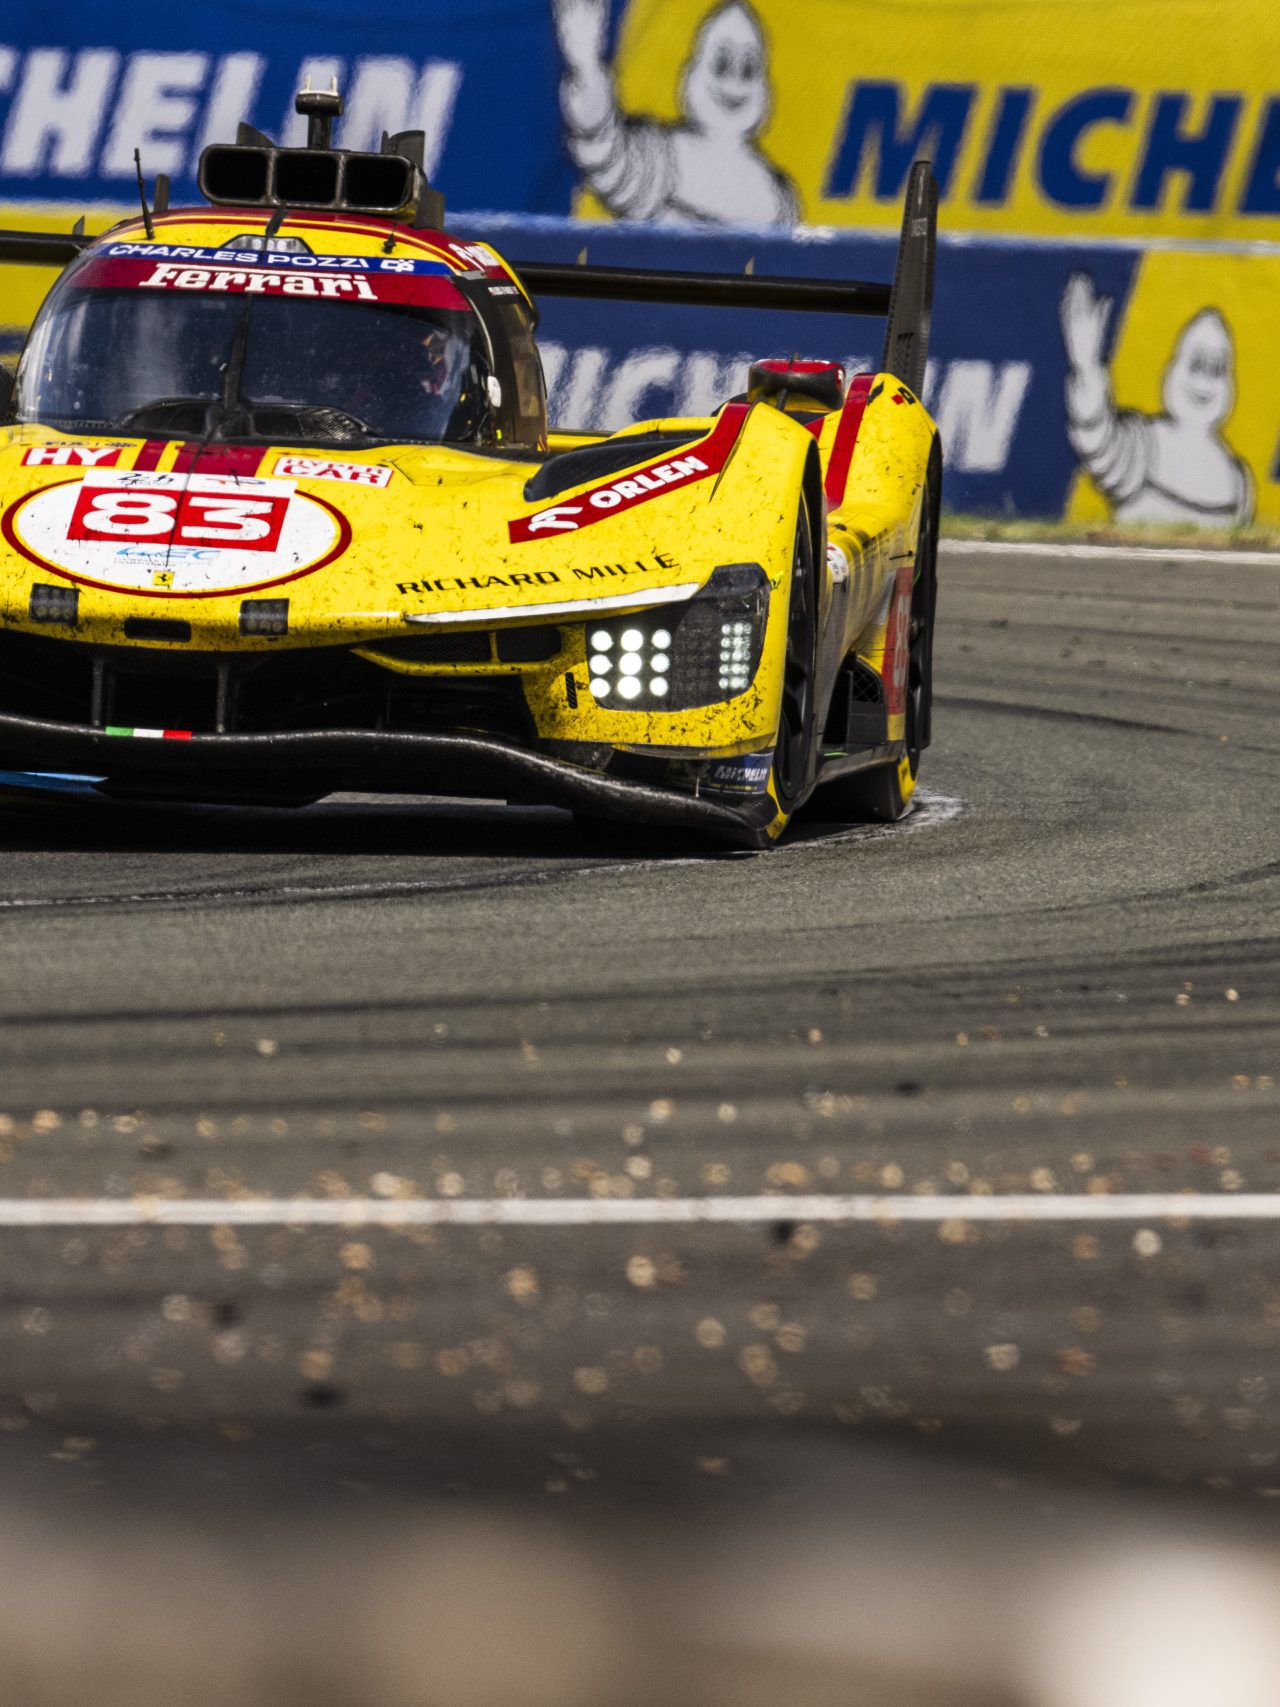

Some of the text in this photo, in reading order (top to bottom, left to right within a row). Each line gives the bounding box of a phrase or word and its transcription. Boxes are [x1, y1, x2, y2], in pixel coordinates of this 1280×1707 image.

[108, 243, 258, 263] CHARLES
[267, 254, 369, 268] POZZI
[138, 262, 378, 300] Ferrari
[25, 447, 119, 466] HY
[282, 464, 380, 485] CAR
[589, 455, 709, 508] ORLEN
[82, 492, 274, 541] 83
[396, 552, 680, 595] RICHARD MILLE
